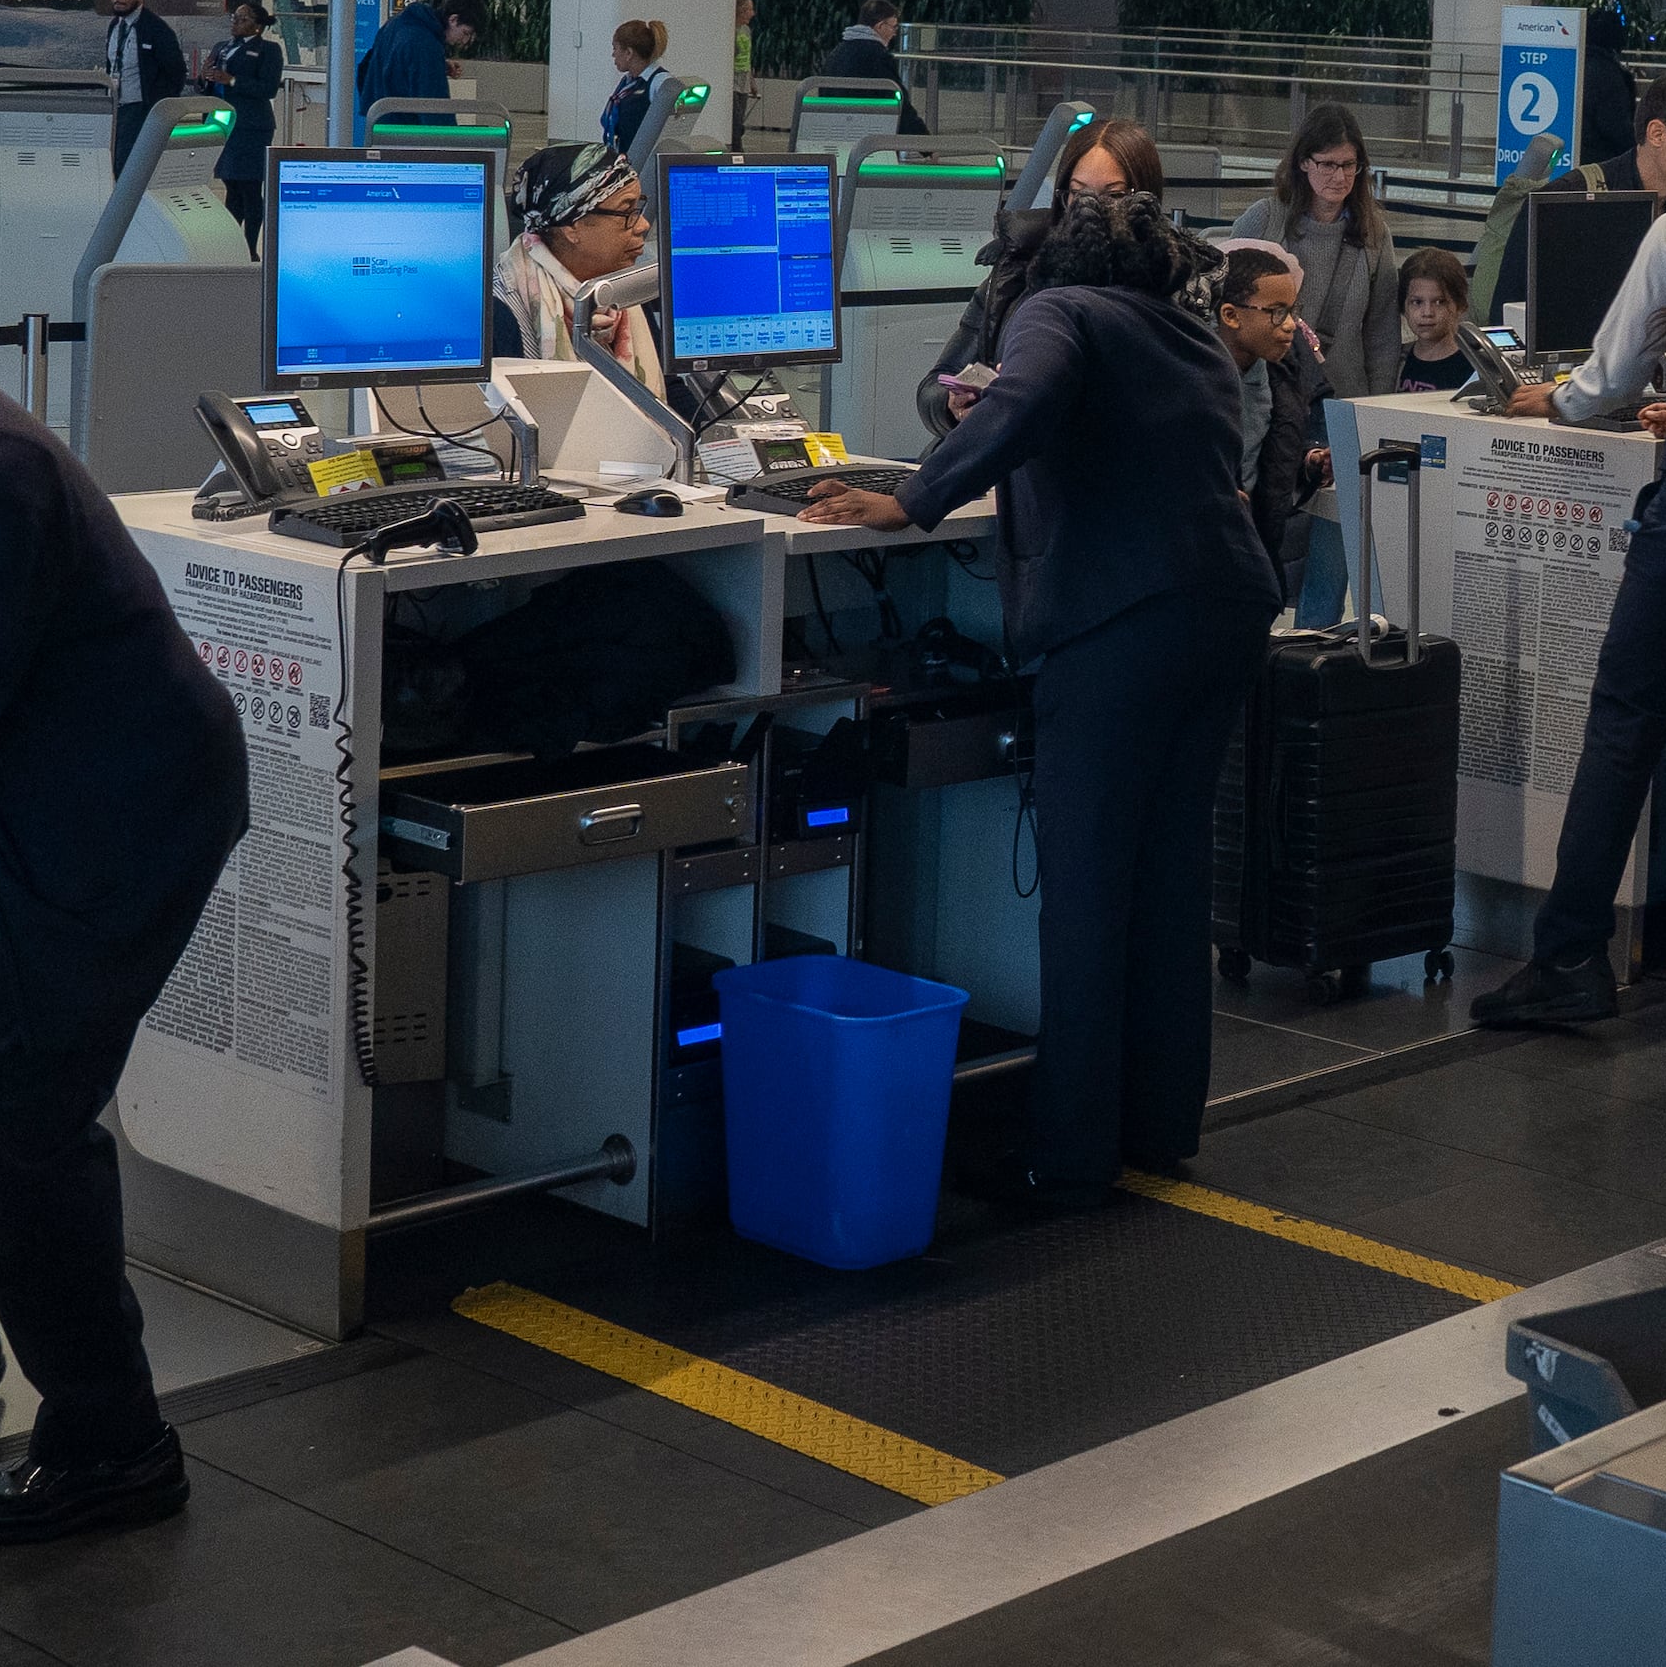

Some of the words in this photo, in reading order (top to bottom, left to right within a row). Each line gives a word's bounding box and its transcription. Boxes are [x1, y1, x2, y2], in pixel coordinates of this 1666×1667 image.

[1517, 22, 1555, 33] American
[1520, 52, 1548, 65] STEP
[1520, 83, 1540, 122] 2
[366, 190, 392, 198] American
[371, 257, 388, 265] Scan
[371, 265, 402, 276] Boarding
[403, 266, 418, 274] Pass
[1491, 437, 1525, 452] ADVICE
[1528, 442, 1540, 454] TO
[1543, 444, 1604, 463] PASSENGERS
[1491, 450, 1534, 462] TRANSPORTATION
[1543, 456, 1574, 467] HAZARDOUS
[1575, 460, 1604, 470] MATERIALS
[185, 562, 220, 584] ADVICE
[223, 570, 235, 586] TO
[238, 573, 303, 601] PASSENGERS
[185, 578, 230, 597] TRANSPORTATION
[231, 588, 238, 598] OF
[239, 589, 271, 606] HAZARDOUS
[273, 596, 303, 611] MATERIALS
